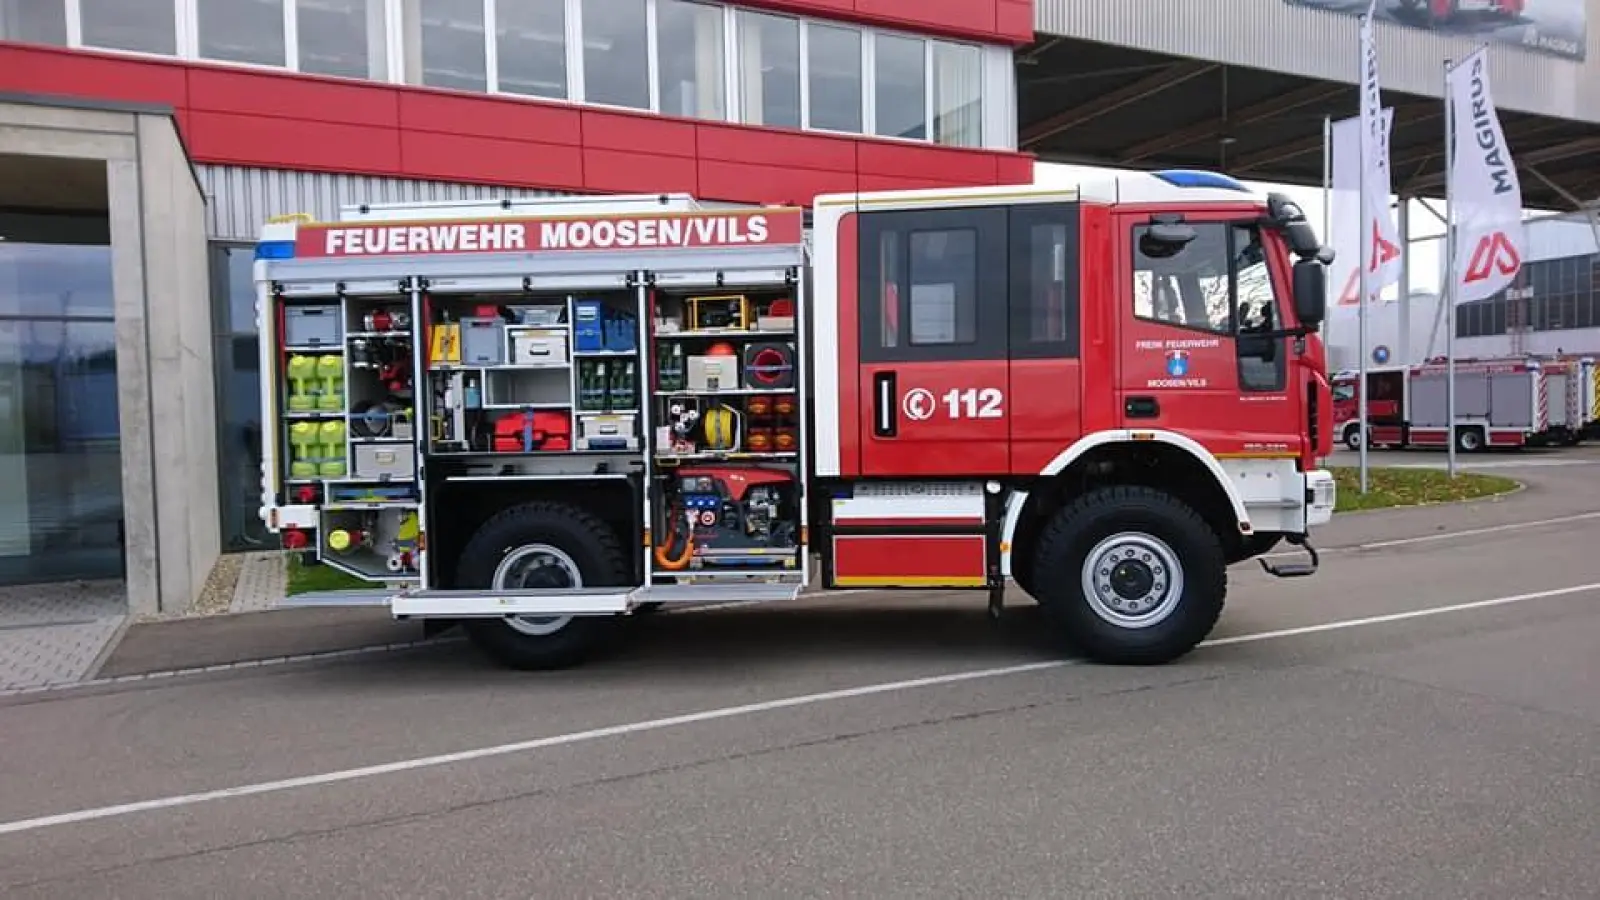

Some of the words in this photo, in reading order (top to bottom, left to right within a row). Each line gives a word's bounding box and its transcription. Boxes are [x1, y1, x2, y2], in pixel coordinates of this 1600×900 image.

[1471, 57, 1513, 195] MAGIRUS
[325, 223, 525, 254] FEUERWEHR
[539, 215, 768, 248] MOOSEN/VILS
[942, 388, 1003, 418] 112
